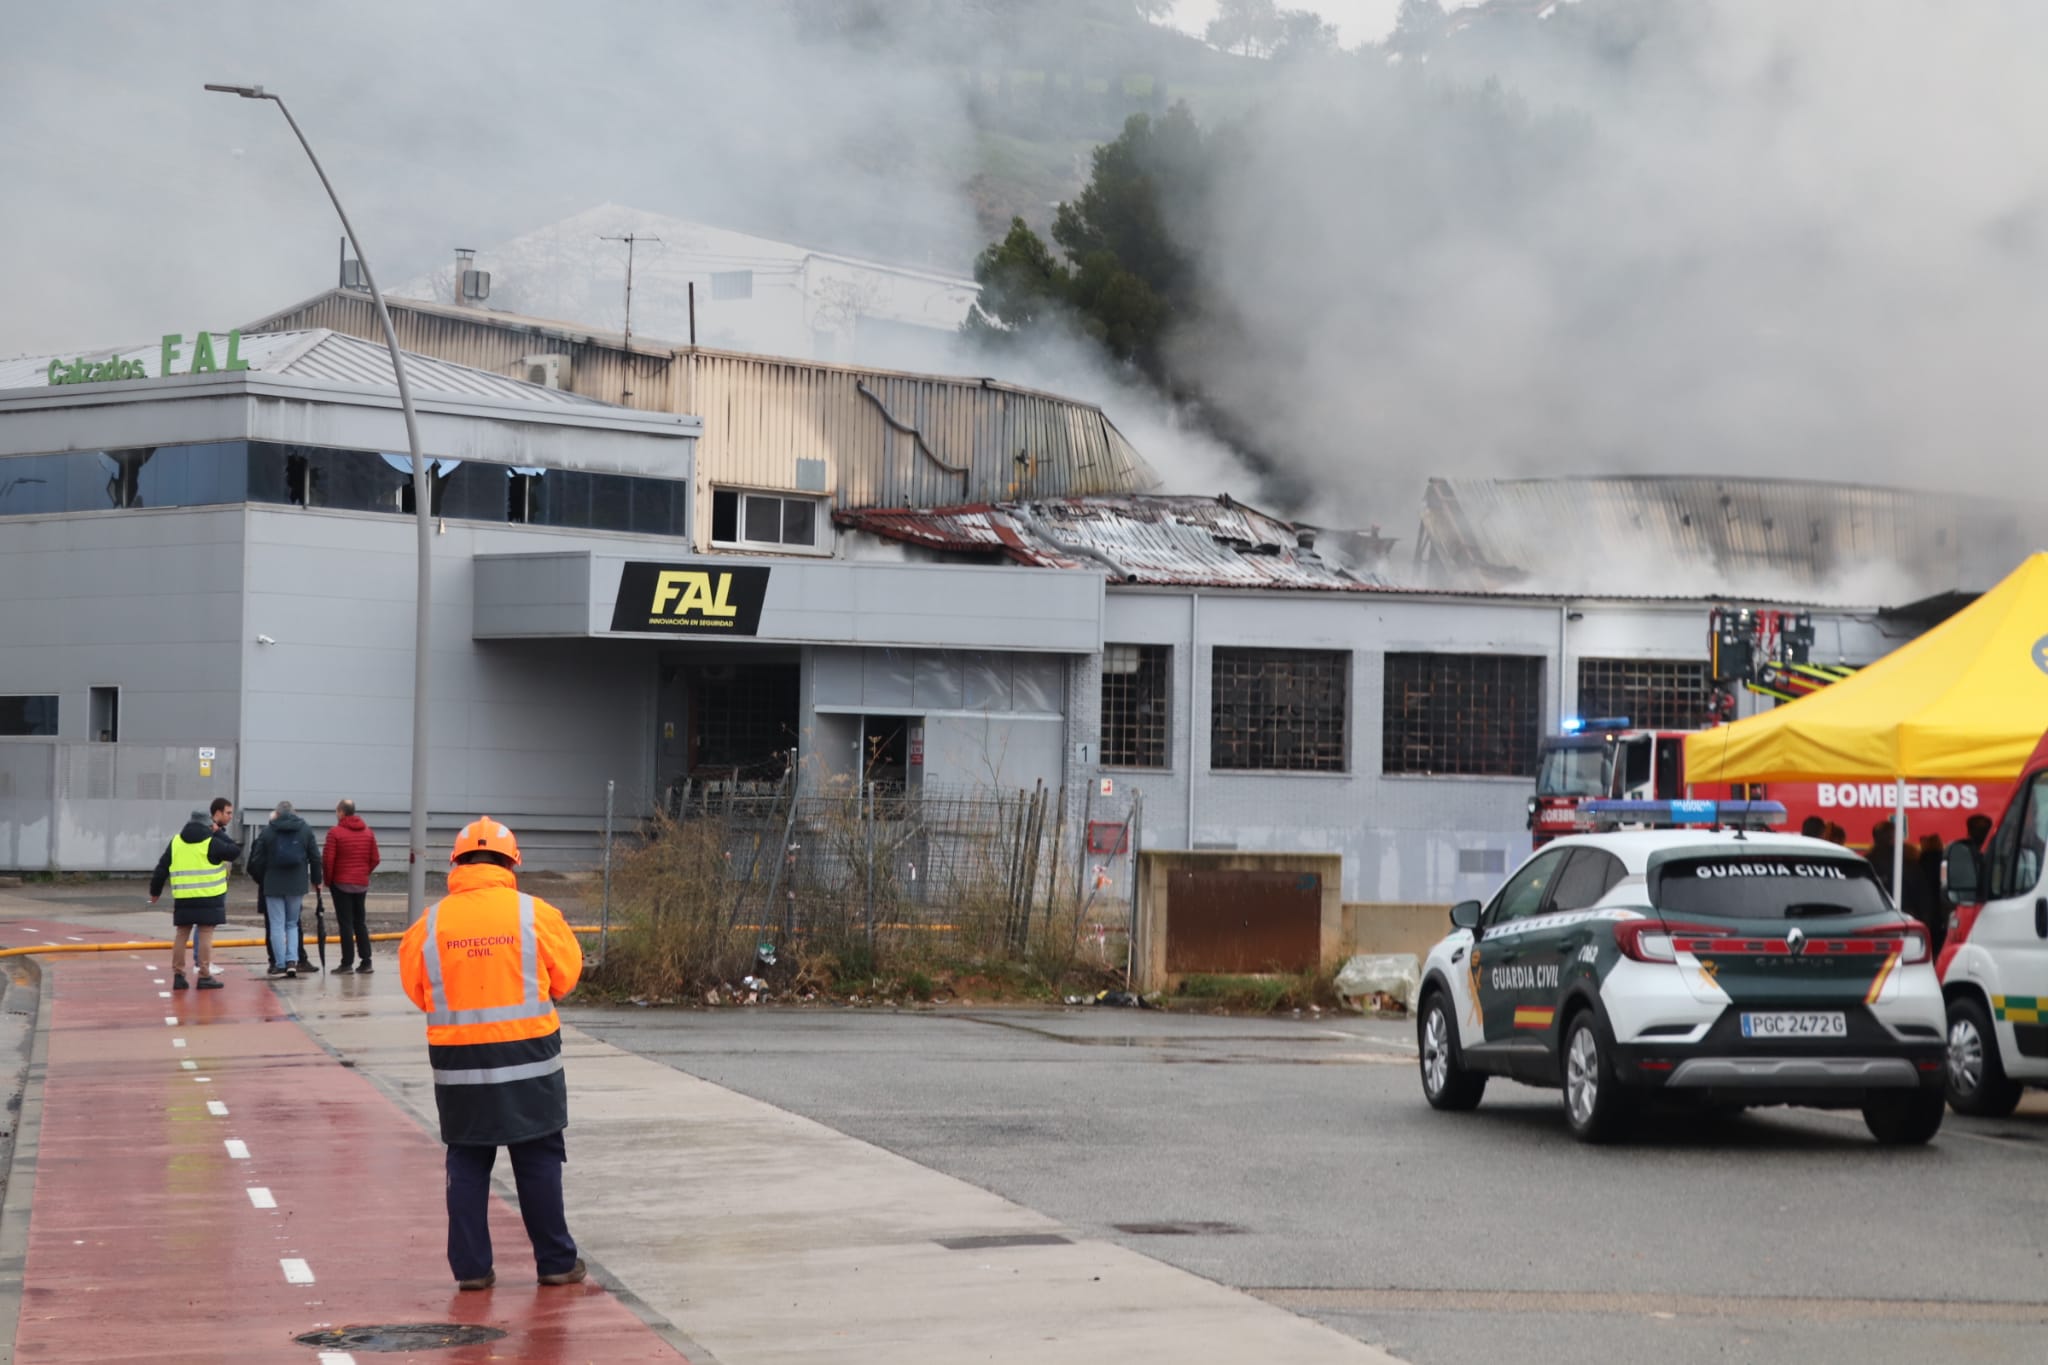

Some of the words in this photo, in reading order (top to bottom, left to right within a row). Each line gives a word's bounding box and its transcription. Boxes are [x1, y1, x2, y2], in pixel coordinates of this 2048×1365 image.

[48, 354, 146, 385] Calzados
[161, 328, 249, 378] FAL
[651, 570, 737, 617] FAL
[649, 617, 689, 625] INNOVACIÓN
[1081, 744, 1088, 763] 1
[1817, 782, 1979, 809] BOMBEROS
[1696, 863, 1791, 879] GUARDIA
[1795, 864, 1847, 880] CIVIL
[467, 947, 494, 958] CIVIL
[1491, 966, 1535, 990] GUARDIA
[1536, 964, 1559, 988] CIVIL
[1753, 1016, 1785, 1033] PGC
[1788, 1015, 1829, 1032] 2472
[1833, 1015, 1844, 1032] G
